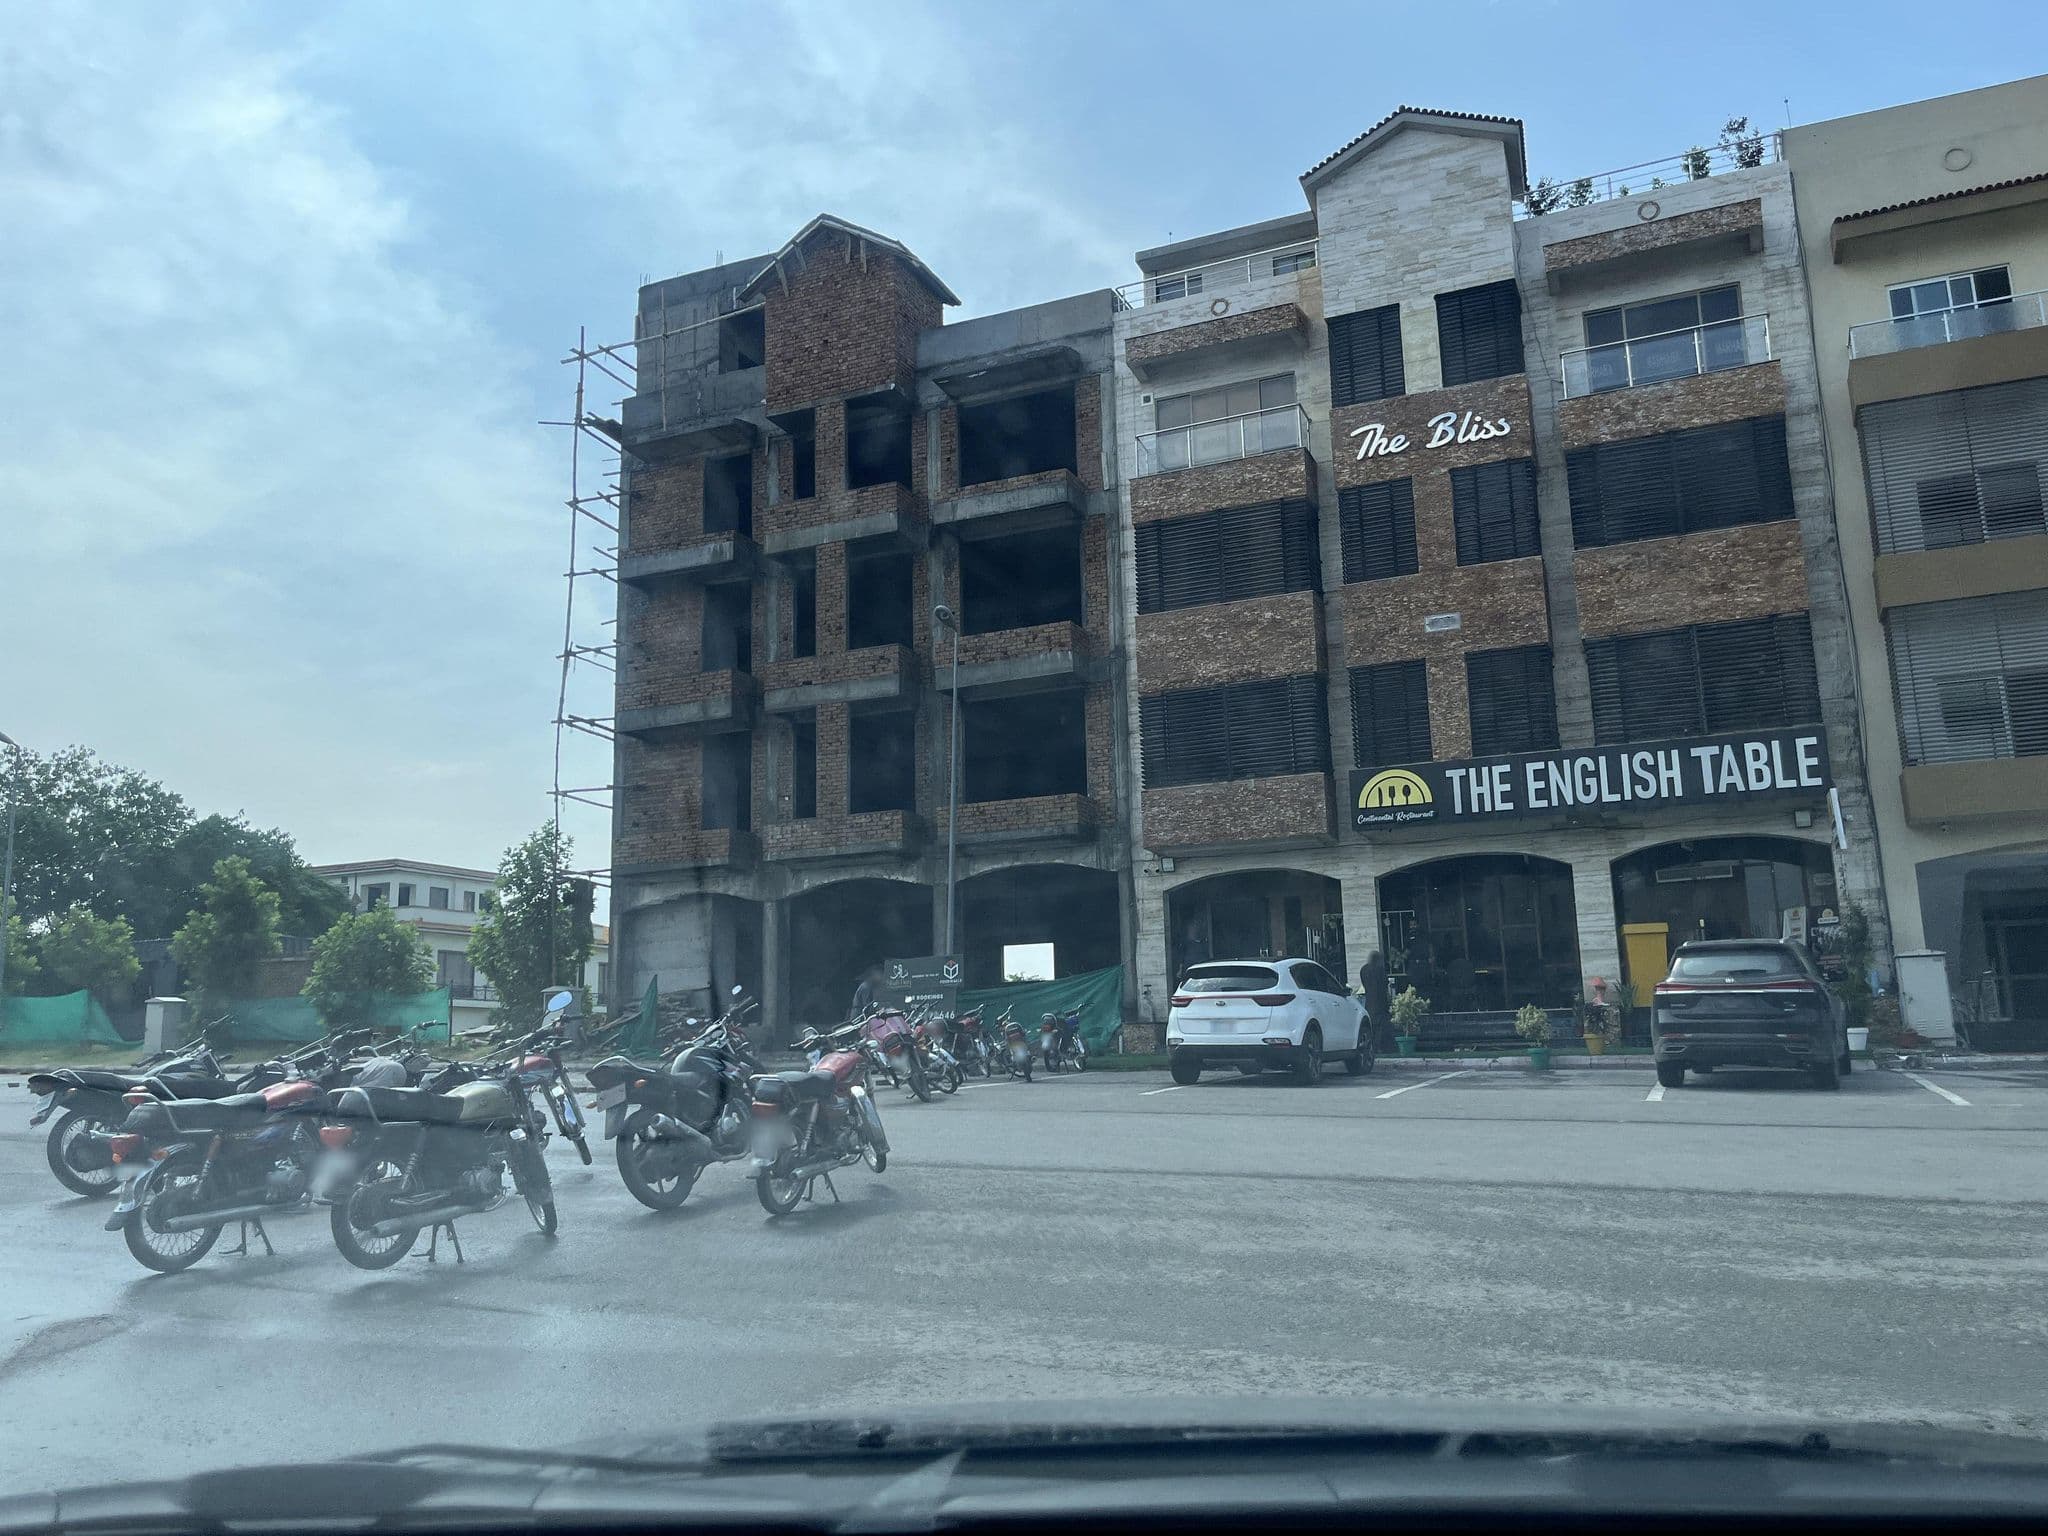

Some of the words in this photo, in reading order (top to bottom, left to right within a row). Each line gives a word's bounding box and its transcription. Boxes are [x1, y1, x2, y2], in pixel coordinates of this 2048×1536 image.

[1350, 423, 1410, 461] The
[1426, 411, 1511, 449] Bliss
[1446, 763, 1514, 814] THE
[1527, 749, 1683, 808] ENGLISH
[1690, 736, 1823, 794] TABLE
[1357, 813, 1394, 825] Continental
[1395, 811, 1435, 822] Restaurant
